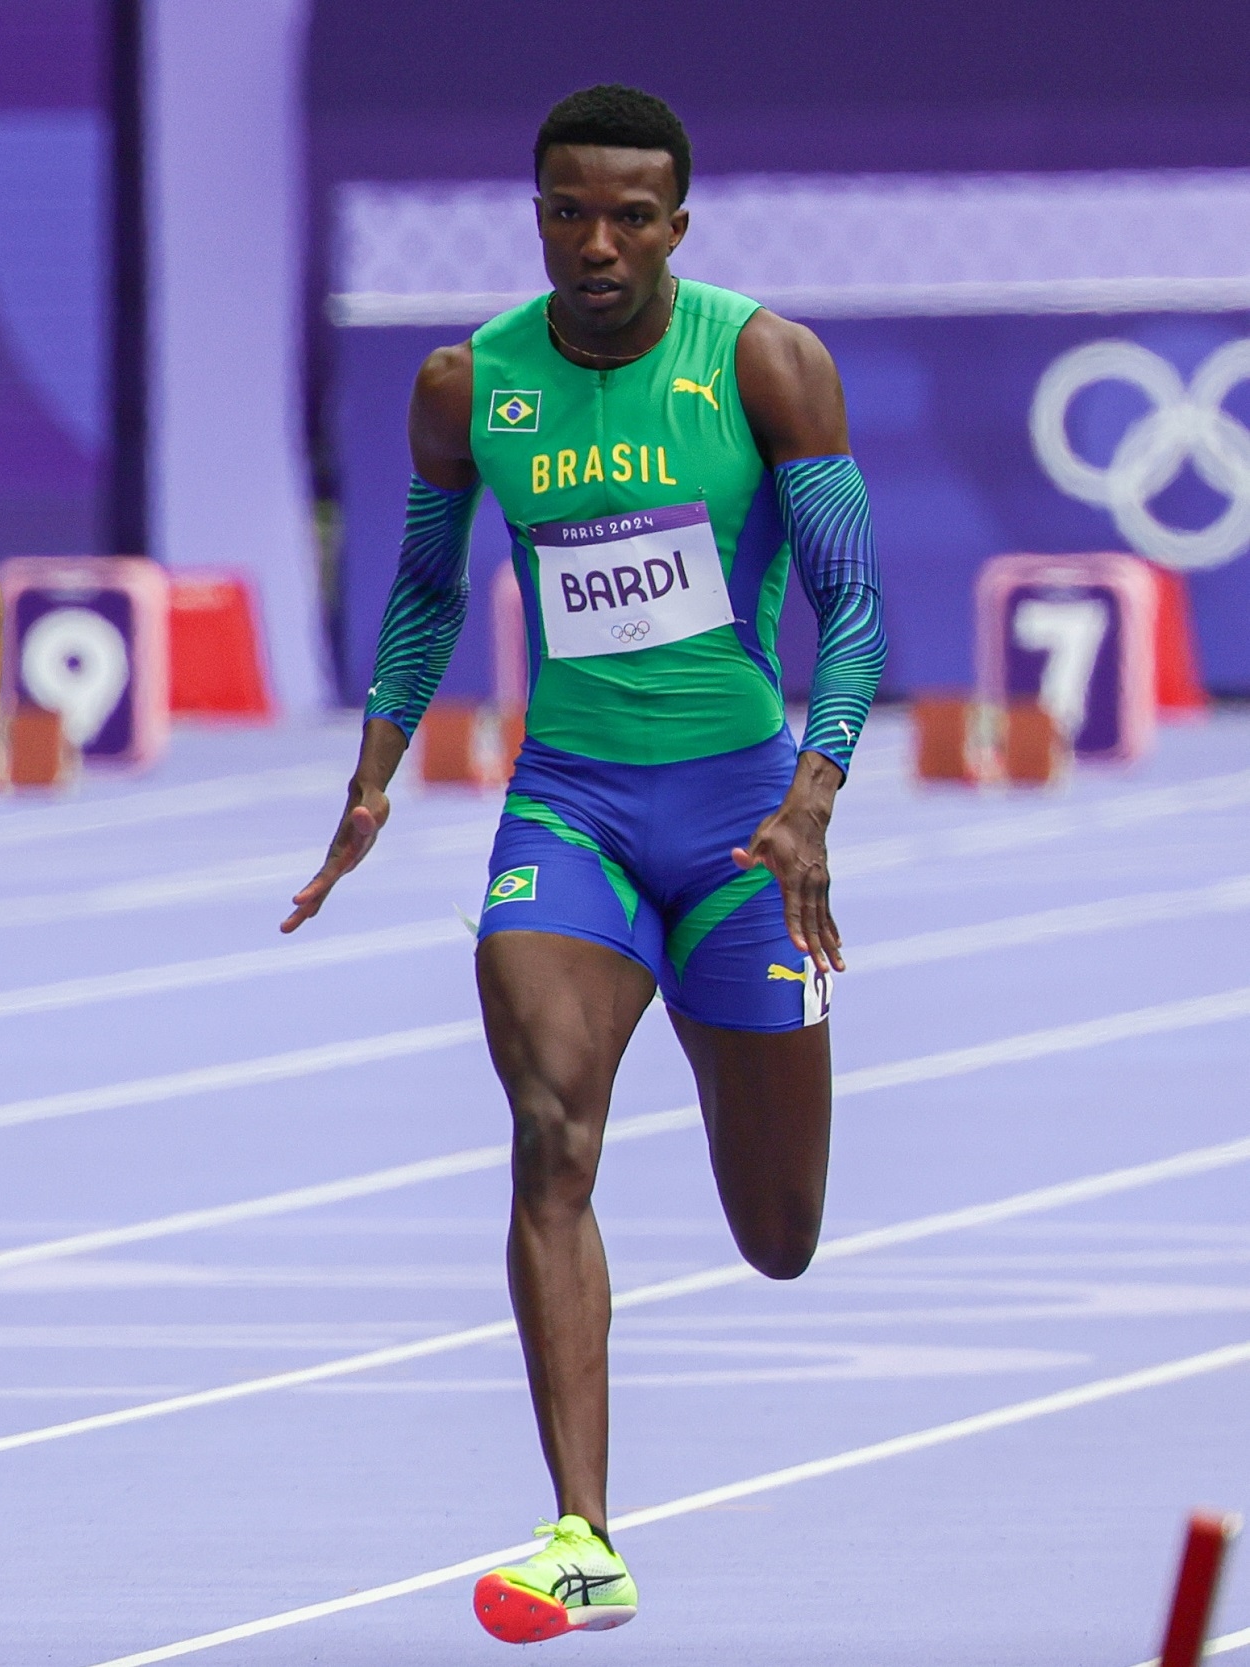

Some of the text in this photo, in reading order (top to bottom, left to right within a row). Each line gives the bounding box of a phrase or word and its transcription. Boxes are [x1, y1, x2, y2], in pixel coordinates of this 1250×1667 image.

[532, 443, 677, 494] BRASIL
[562, 516, 654, 540] PARIS 2024
[561, 550, 690, 613] BARDI
[21, 606, 131, 748] 9
[1012, 598, 1109, 736] 7
